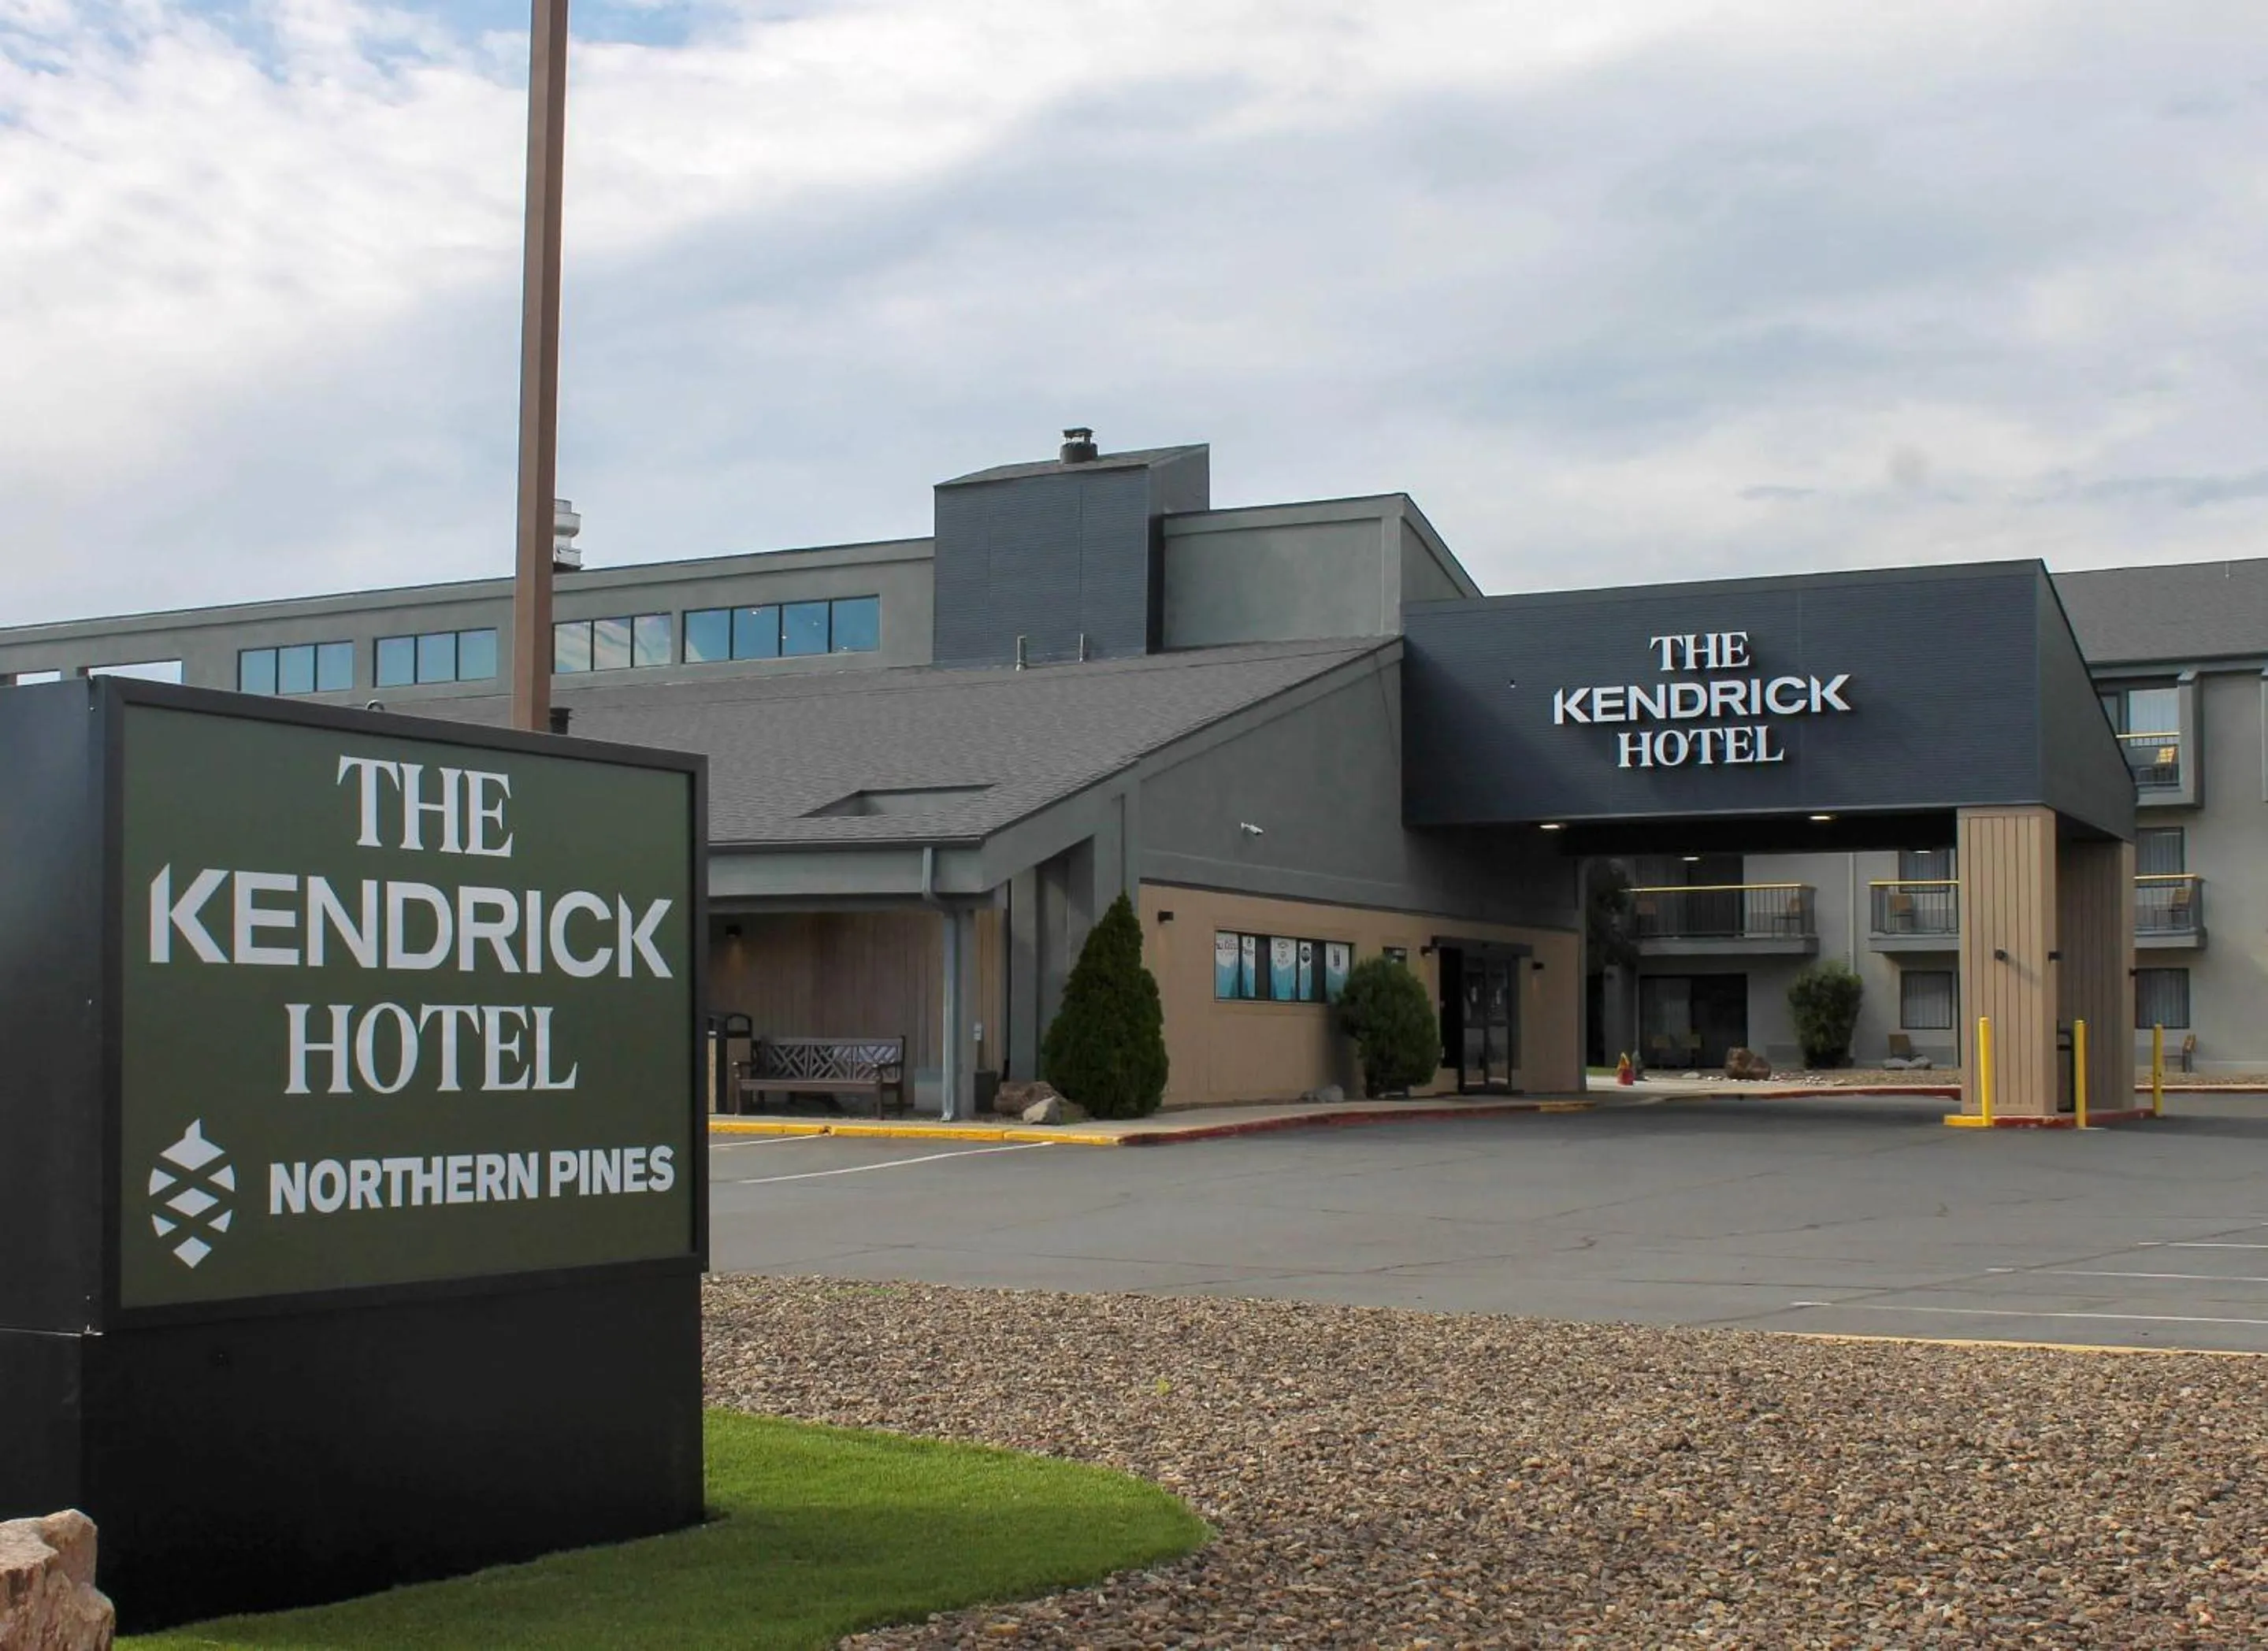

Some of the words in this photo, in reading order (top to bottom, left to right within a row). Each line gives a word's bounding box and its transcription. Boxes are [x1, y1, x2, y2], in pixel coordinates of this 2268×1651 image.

[1649, 631, 1750, 671] THE
[1553, 673, 1851, 725] KENDRICK
[1617, 725, 1785, 768] HOTEL
[336, 755, 514, 858] THE
[150, 863, 674, 978] KENDRICK
[284, 1001, 578, 1094] HOTEL
[269, 1151, 540, 1215] NORTHERN
[548, 1145, 675, 1198] PINES
